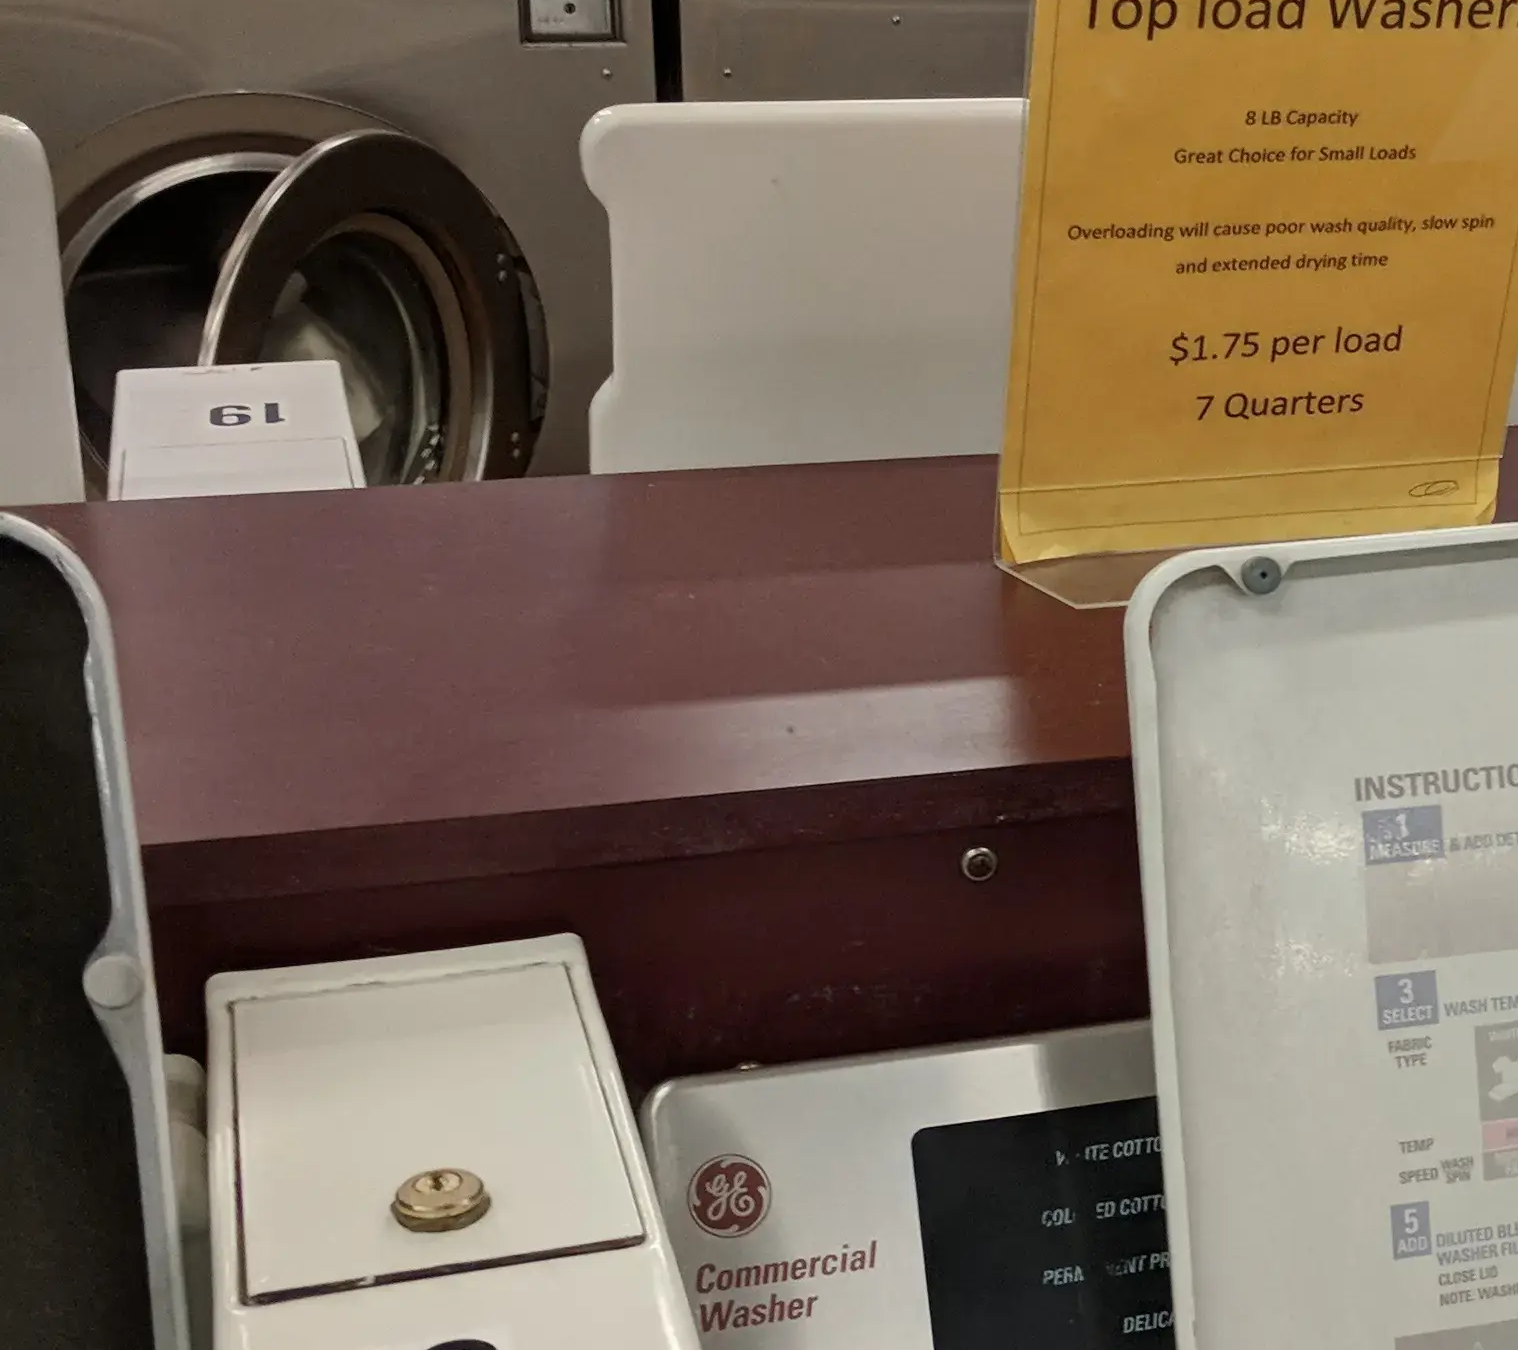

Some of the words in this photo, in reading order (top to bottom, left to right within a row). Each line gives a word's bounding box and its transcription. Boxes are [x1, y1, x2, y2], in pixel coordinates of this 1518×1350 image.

[1244, 110, 1257, 127] 8
[1261, 110, 1282, 126] LB
[1286, 109, 1359, 129] Capacity
[1173, 148, 1224, 165] Great
[1228, 147, 1286, 164] Choice
[1290, 147, 1315, 163] for
[1318, 145, 1365, 162] Small
[1369, 144, 1417, 161] Loads
[1067, 222, 1175, 243] Overloading
[1179, 221, 1209, 238] will
[1213, 222, 1261, 237] cause
[1265, 220, 1306, 238] poor
[1310, 218, 1352, 234] wash
[1356, 215, 1417, 236] quality,
[1421, 215, 1458, 231] slow
[1461, 214, 1495, 232] spin
[1175, 258, 1208, 275] and
[1211, 255, 1291, 273] extended
[1295, 253, 1348, 272] drying
[1351, 252, 1389, 268] time
[1169, 331, 1260, 366] $1.75
[1270, 333, 1326, 363] per
[1334, 324, 1403, 353] load
[1196, 395, 1215, 421] 7
[1224, 391, 1365, 420] Quarters
[1463, 833, 1493, 851] ADD
[1397, 978, 1414, 1004] 3
[1382, 1004, 1434, 1025] SELECT
[1442, 997, 1488, 1017] WASH
[1387, 1035, 1433, 1055] FABRIC
[1395, 1052, 1428, 1069] TYPE
[1398, 1137, 1434, 1155] TEMP
[1440, 1156, 1474, 1171] WASH
[1398, 1167, 1439, 1185] SPEED
[705, 1170, 756, 1221] GE
[1403, 1208, 1419, 1235] 5
[1397, 1236, 1428, 1253] ADD
[1436, 1225, 1494, 1249] DILUTED
[1436, 1243, 1500, 1266] WASHER
[695, 1239, 878, 1295] Commercial
[1438, 1269, 1477, 1287] CLOSE
[1479, 1264, 1499, 1281] LID
[700, 1293, 820, 1333] Washer
